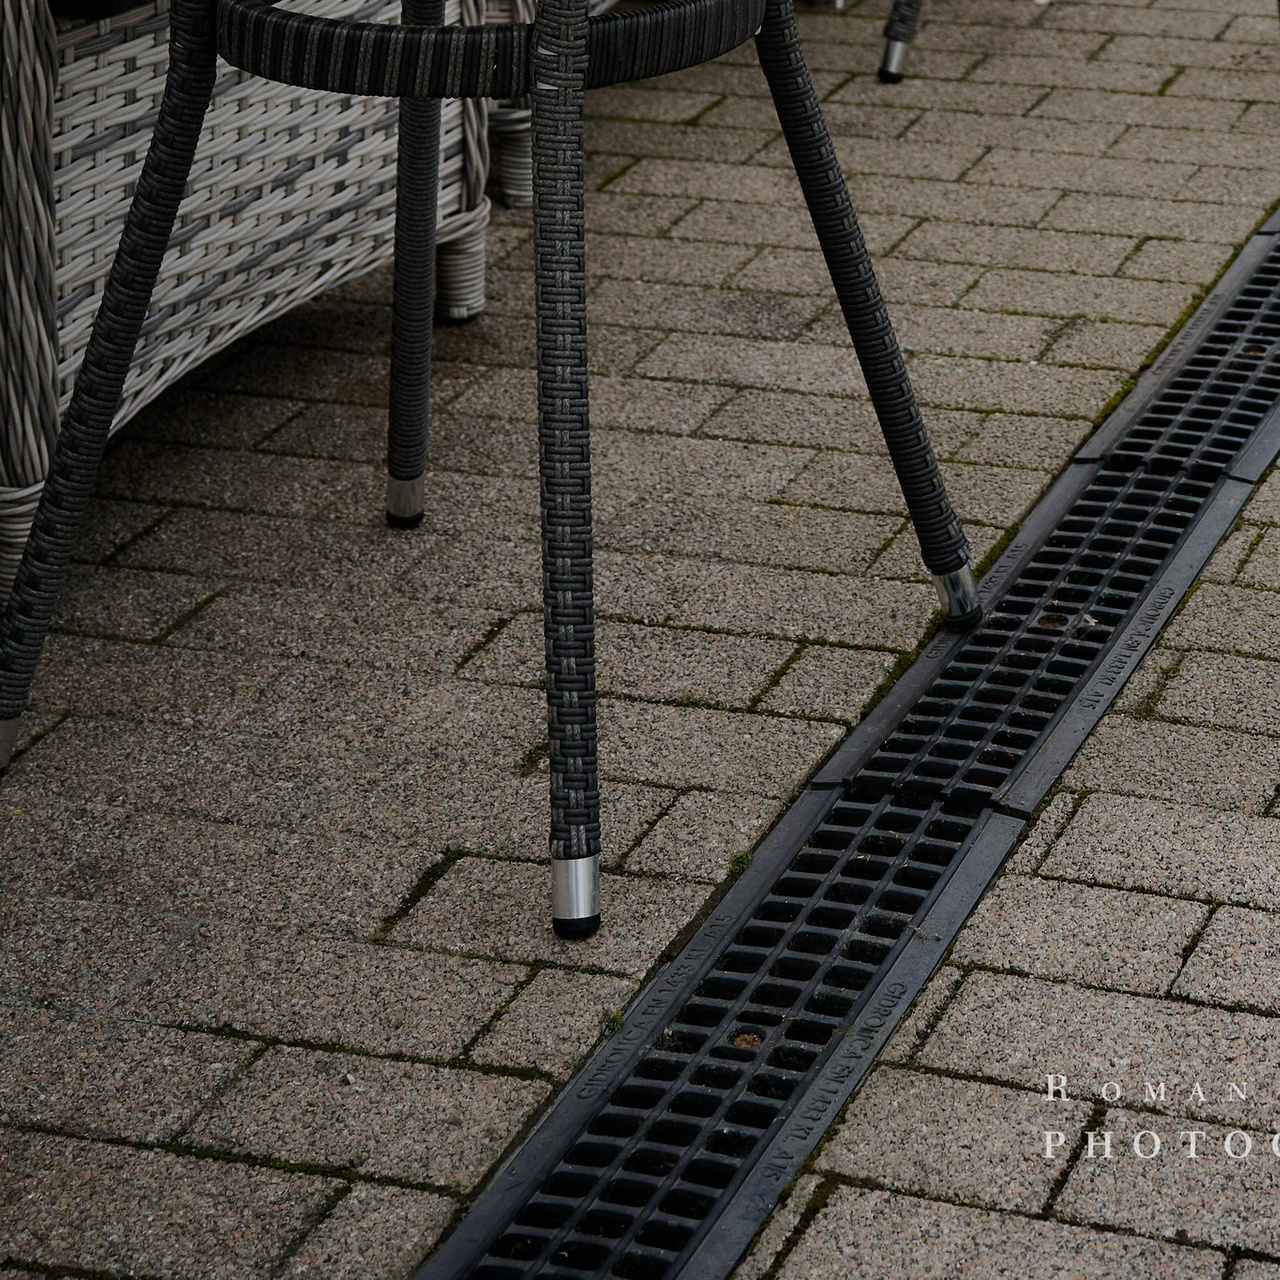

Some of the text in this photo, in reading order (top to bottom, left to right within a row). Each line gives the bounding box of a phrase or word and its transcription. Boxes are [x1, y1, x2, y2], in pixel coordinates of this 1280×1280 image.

[641, 998, 668, 1016] EN
[703, 915, 734, 939] A15
[761, 1148, 794, 1182] A15
